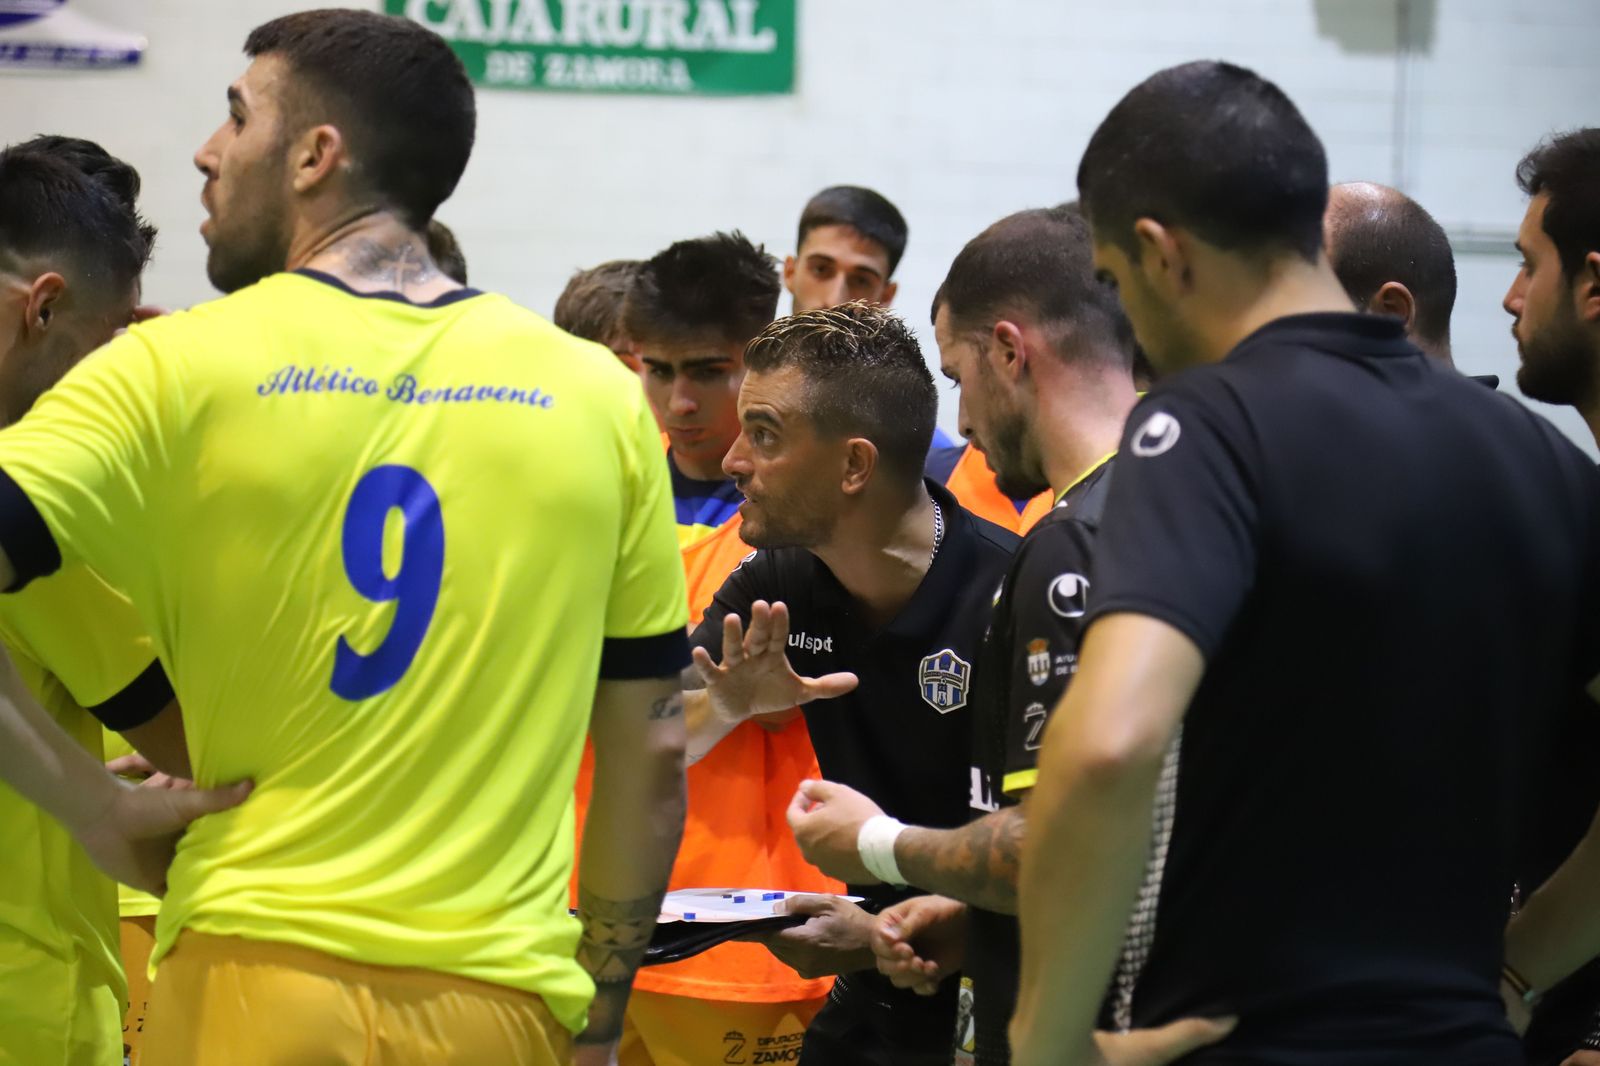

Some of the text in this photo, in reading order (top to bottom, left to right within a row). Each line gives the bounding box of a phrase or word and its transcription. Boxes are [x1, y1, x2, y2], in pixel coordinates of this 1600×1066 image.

[485, 51, 694, 90] DE ZAMORA
[256, 364, 555, 409] Atlético Benavente
[329, 463, 445, 702] 9
